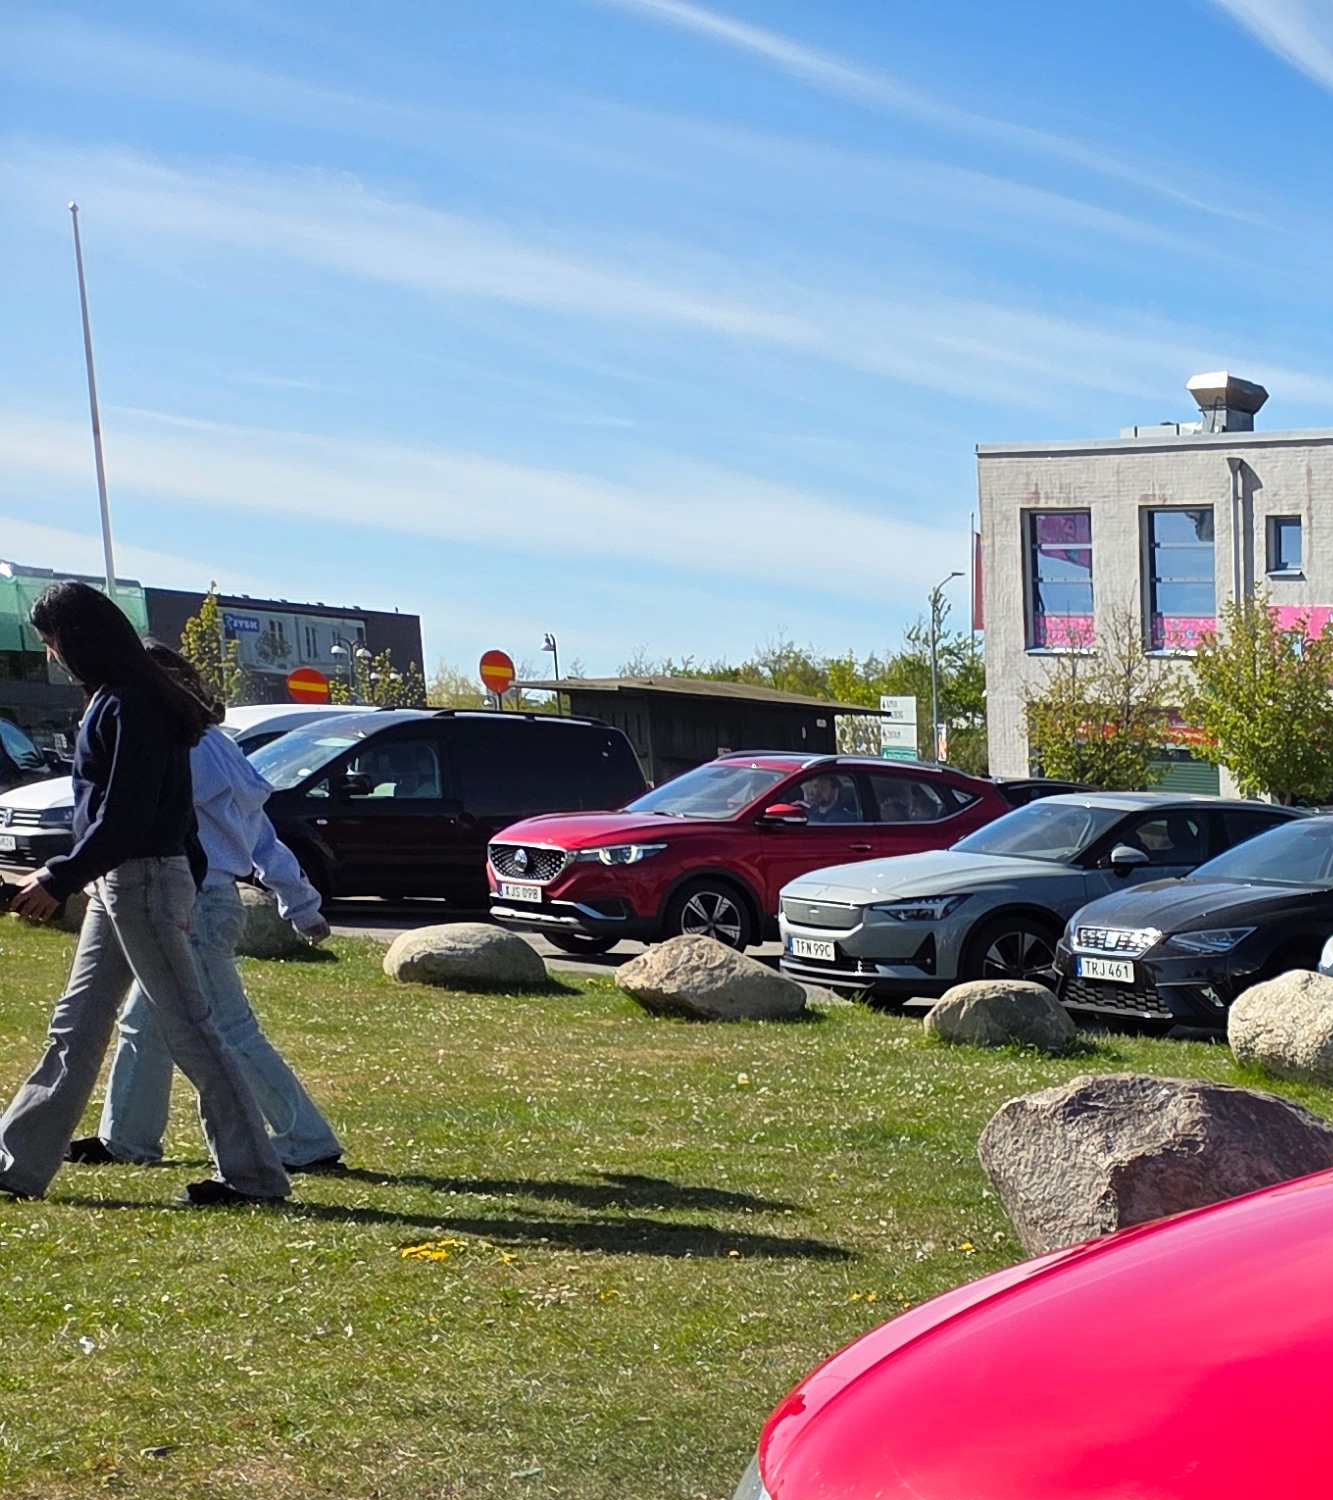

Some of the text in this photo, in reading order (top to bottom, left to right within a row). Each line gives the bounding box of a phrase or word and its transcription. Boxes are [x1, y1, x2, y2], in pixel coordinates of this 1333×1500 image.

[795, 939, 812, 954] TFN
[1085, 960, 1129, 979] TRJ 461
